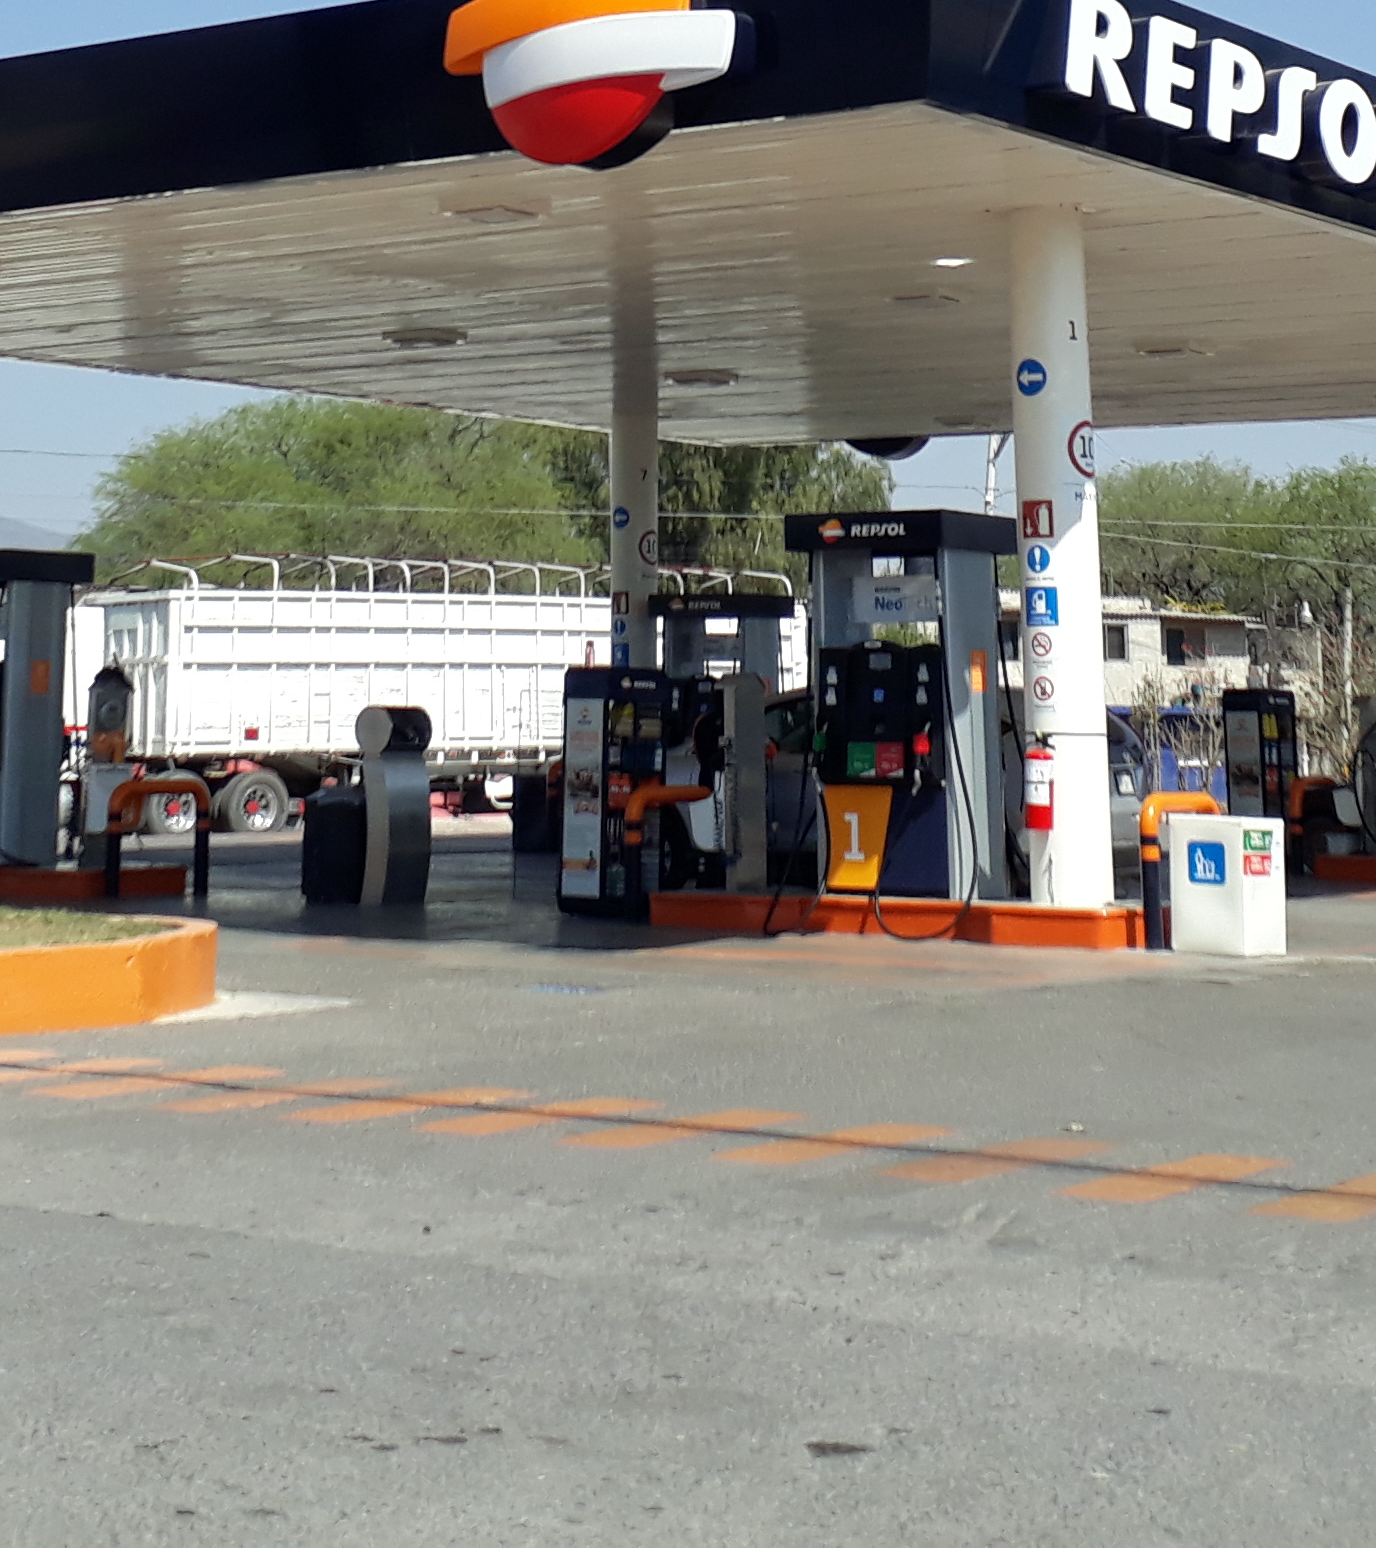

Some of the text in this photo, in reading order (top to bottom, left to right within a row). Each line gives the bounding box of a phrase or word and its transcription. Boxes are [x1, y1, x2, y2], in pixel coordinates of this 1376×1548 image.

[1069, 320, 1078, 341] 1
[850, 522, 906, 538] REPSOL
[844, 812, 865, 862] 1
